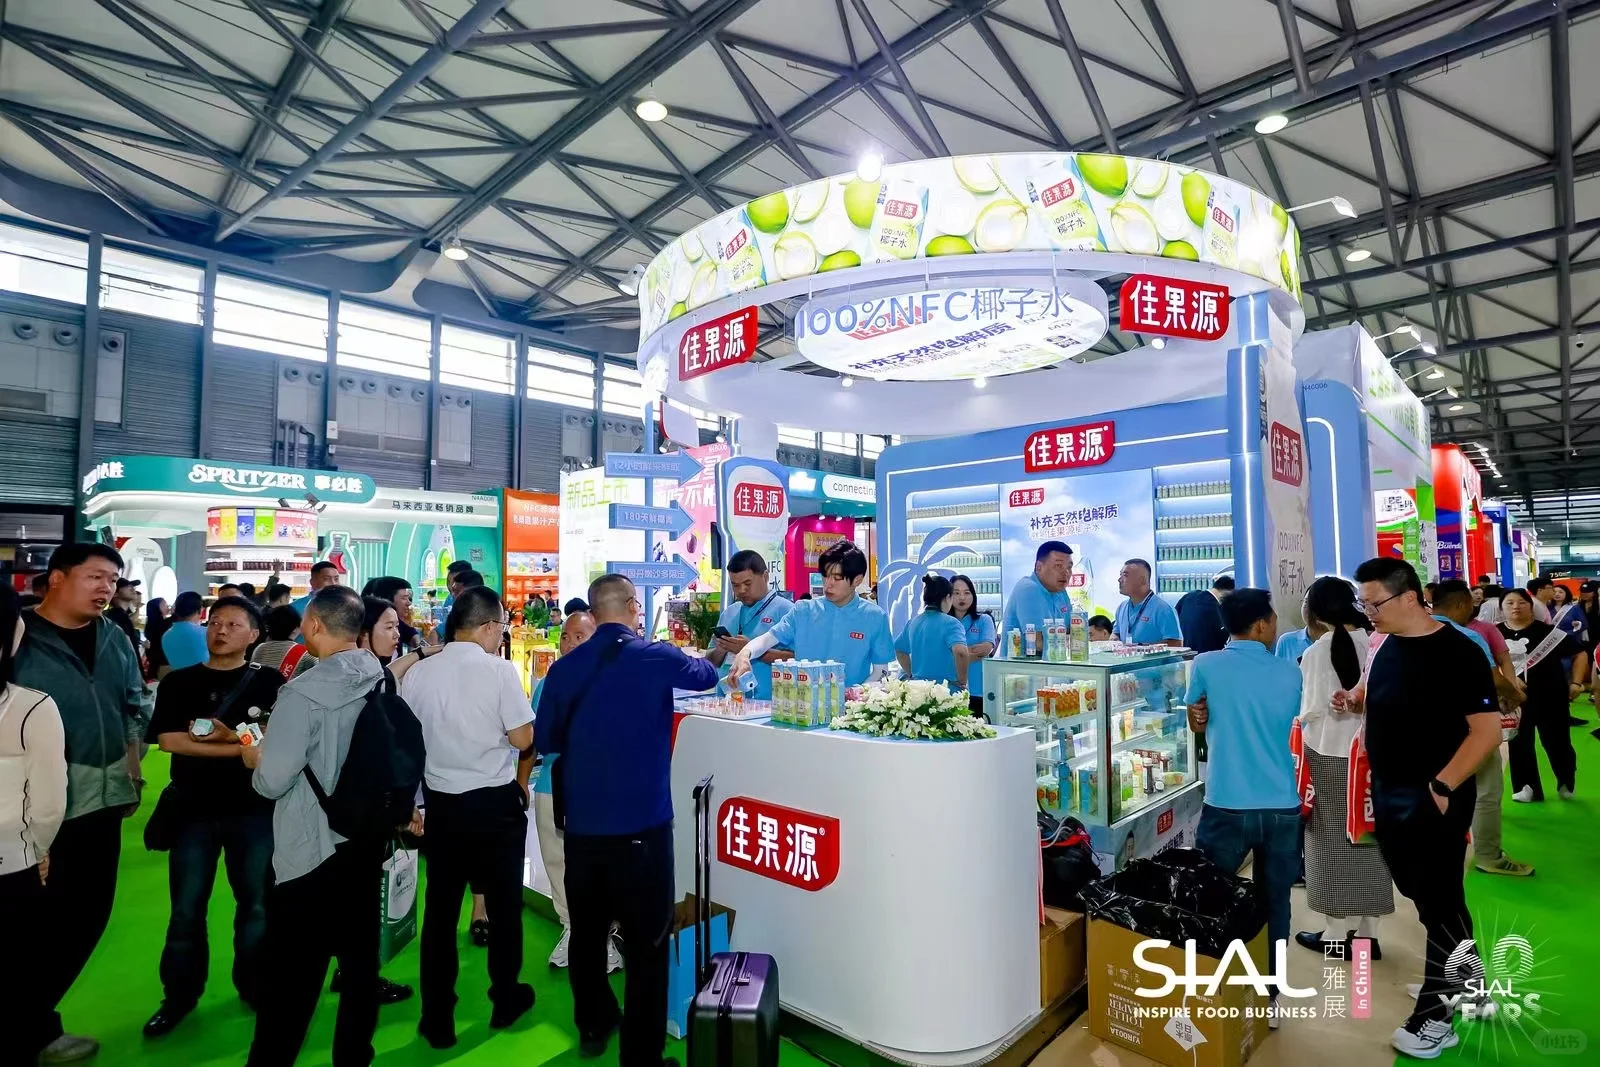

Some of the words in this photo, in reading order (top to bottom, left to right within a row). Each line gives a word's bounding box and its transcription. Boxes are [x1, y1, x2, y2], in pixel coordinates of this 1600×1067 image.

[886, 201, 915, 218] 佳果源
[1129, 280, 1221, 334] 佳果源
[681, 314, 747, 373] 佳果源
[1028, 428, 1106, 467] 佳果源
[1272, 428, 1302, 482] 佳果源
[188, 464, 307, 489] SPRITZER
[391, 500, 474, 514] 马来西亚畅销品牌
[736, 487, 780, 515] 佳果源
[1010, 489, 1042, 505] 佳果源
[1030, 503, 1118, 531] 补充天然电解质
[722, 805, 819, 882] 佳果源
